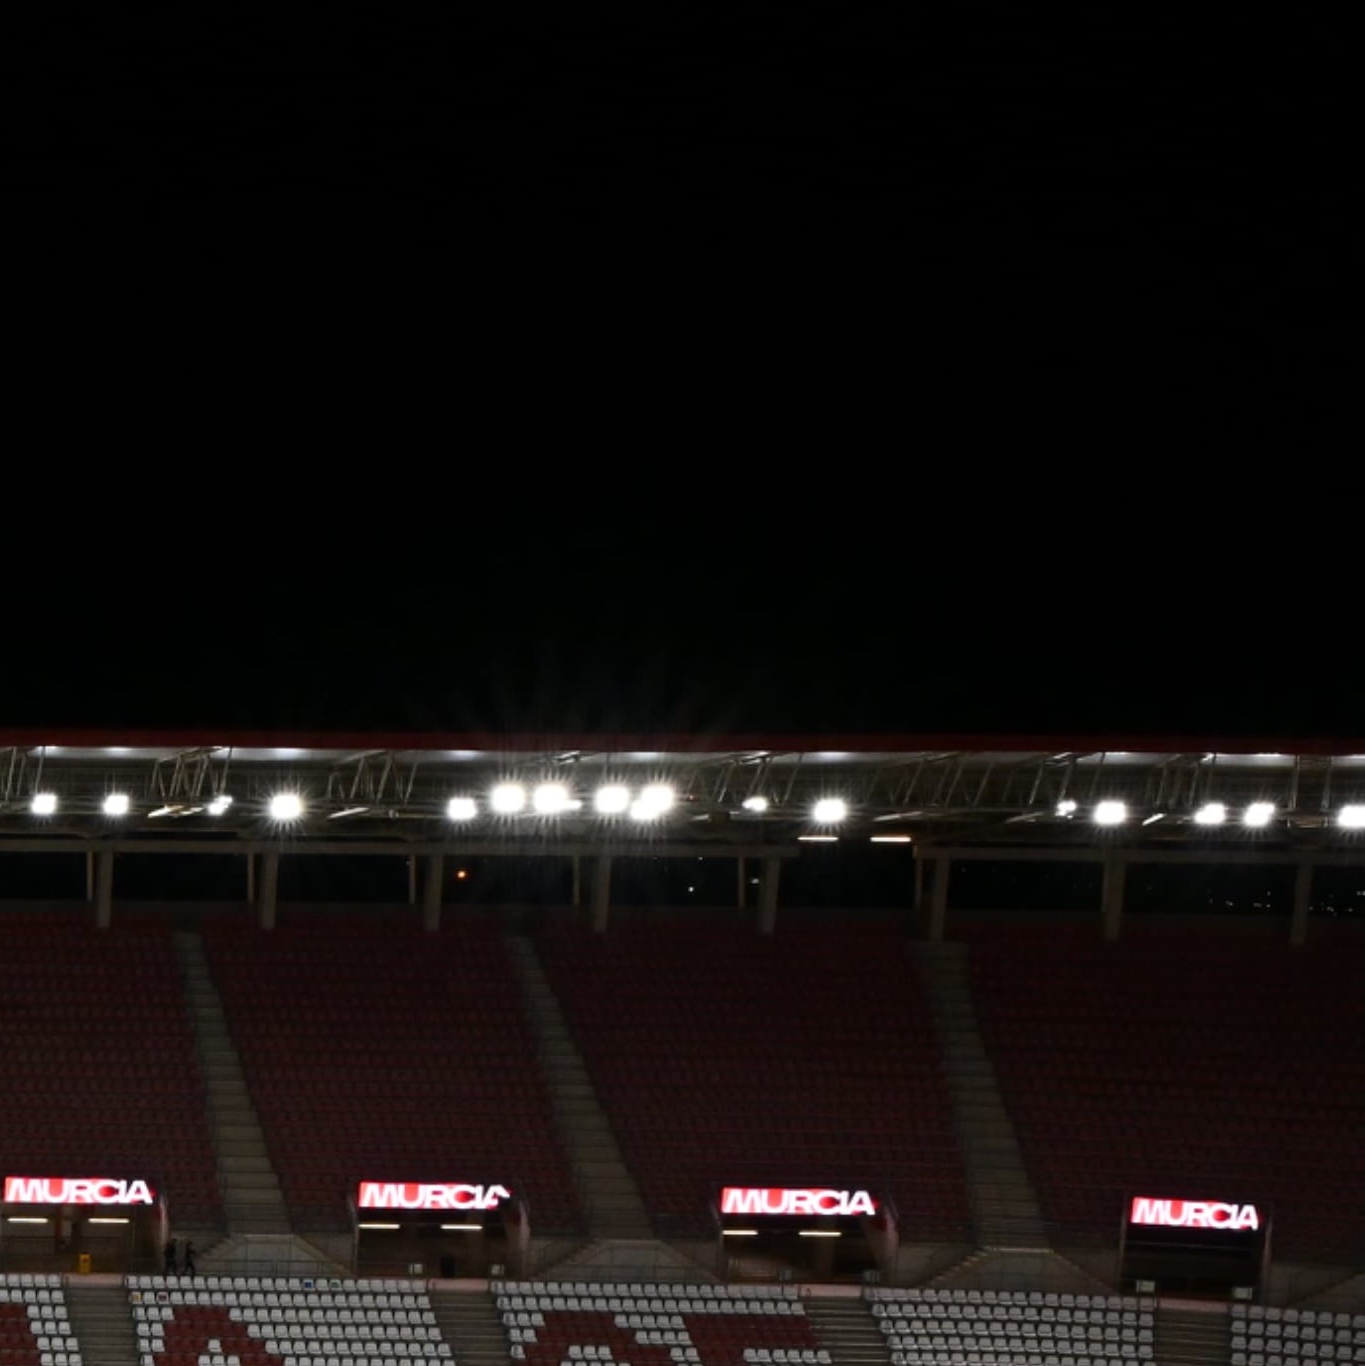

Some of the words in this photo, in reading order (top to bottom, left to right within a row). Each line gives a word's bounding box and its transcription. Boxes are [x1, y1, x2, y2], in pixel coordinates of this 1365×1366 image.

[7, 1178, 152, 1203] MURCIA
[726, 1190, 874, 1215] MURCIA
[1134, 1198, 1258, 1231] MURCIA
